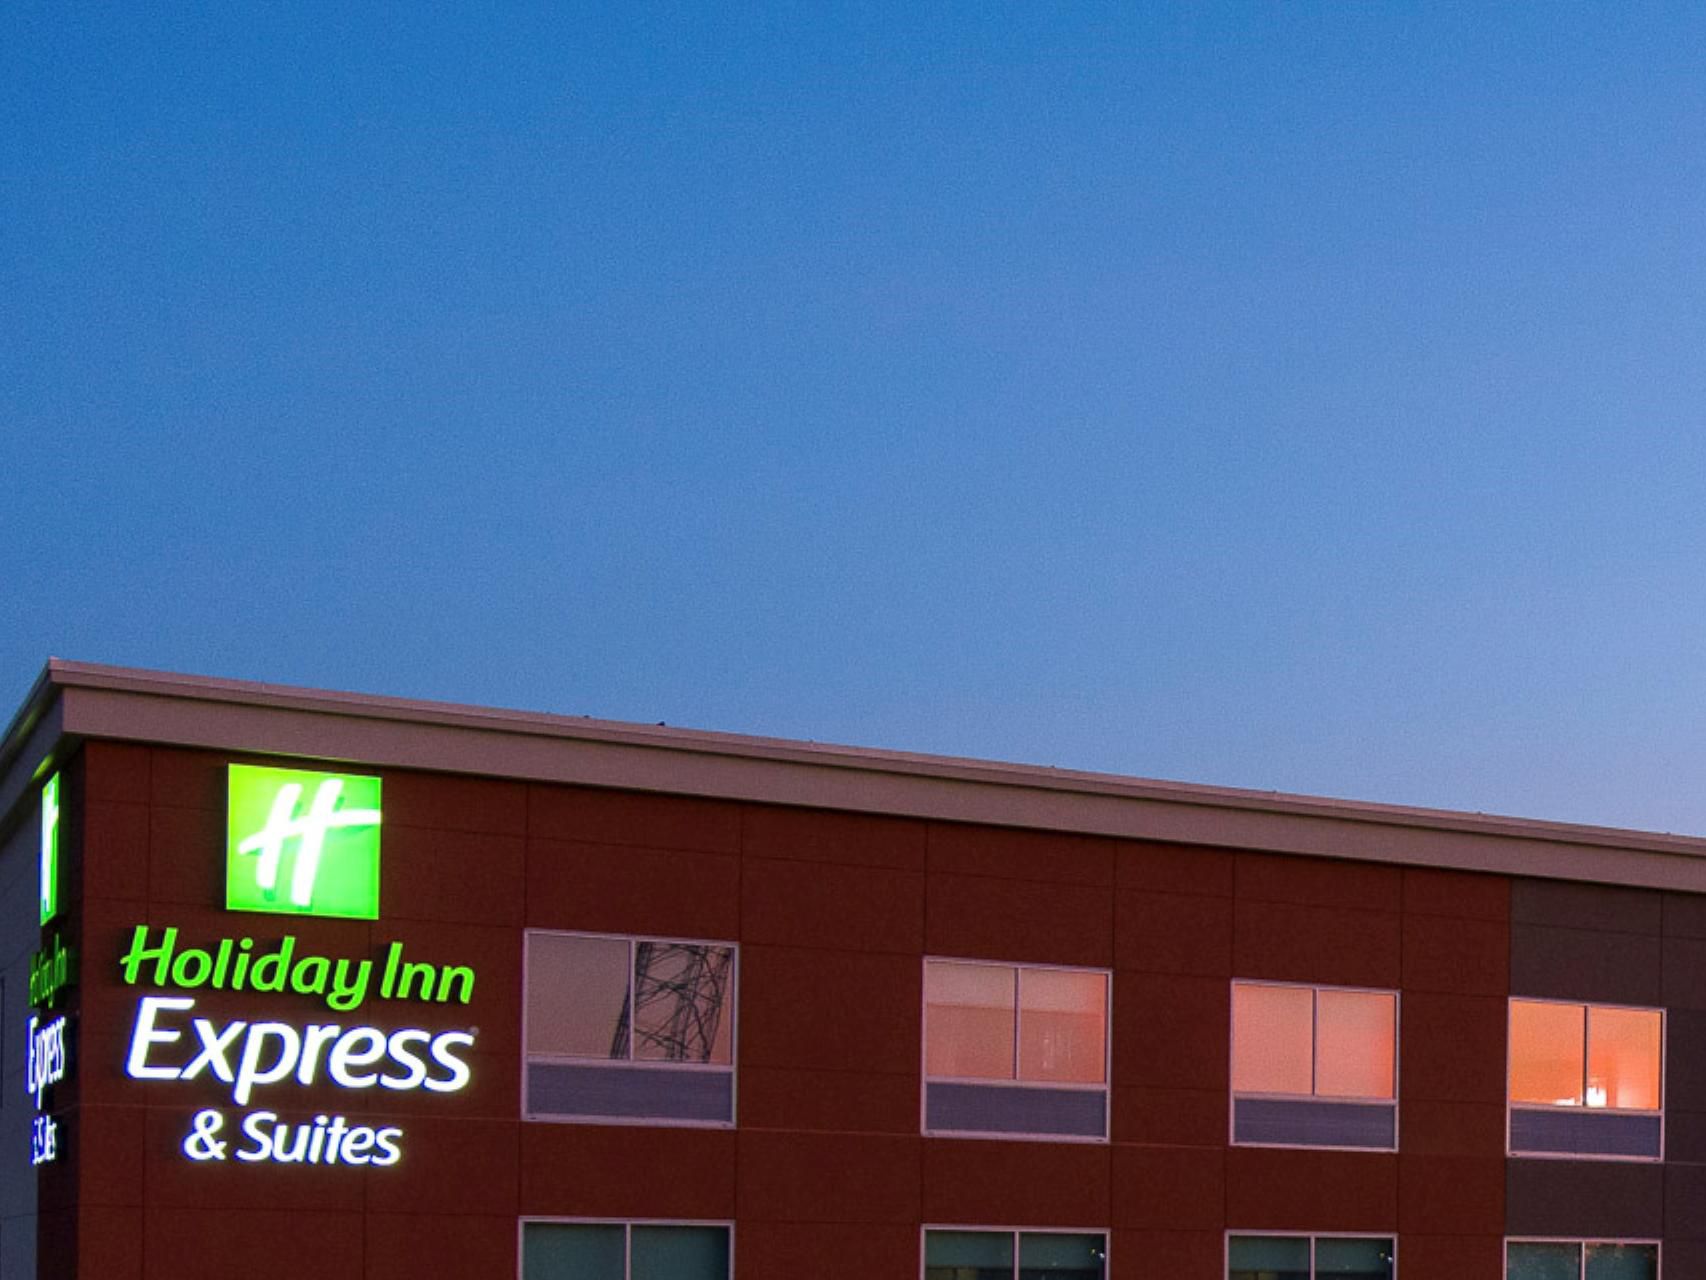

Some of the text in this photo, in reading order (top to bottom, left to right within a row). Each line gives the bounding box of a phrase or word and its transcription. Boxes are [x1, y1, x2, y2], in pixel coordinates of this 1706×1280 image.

[120, 925, 370, 1011] Holiday
[380, 942, 475, 1003] Inn
[126, 996, 475, 1105] Express
[182, 1108, 403, 1166] & Suites
